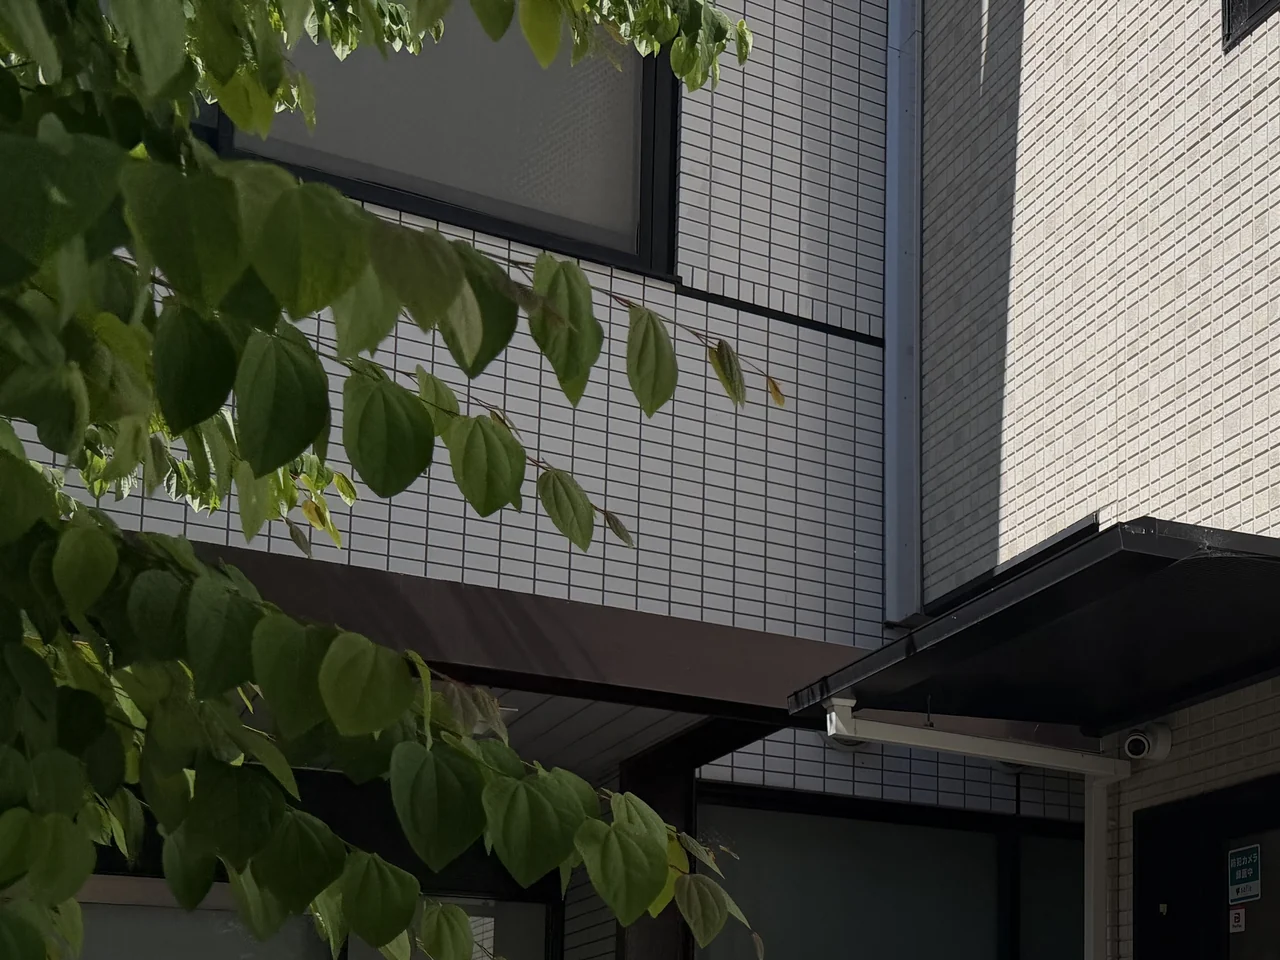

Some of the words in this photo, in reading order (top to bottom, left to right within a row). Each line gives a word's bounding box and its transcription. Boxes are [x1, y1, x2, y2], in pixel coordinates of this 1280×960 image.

[1230, 853, 1258, 868] 防犯カメラ
